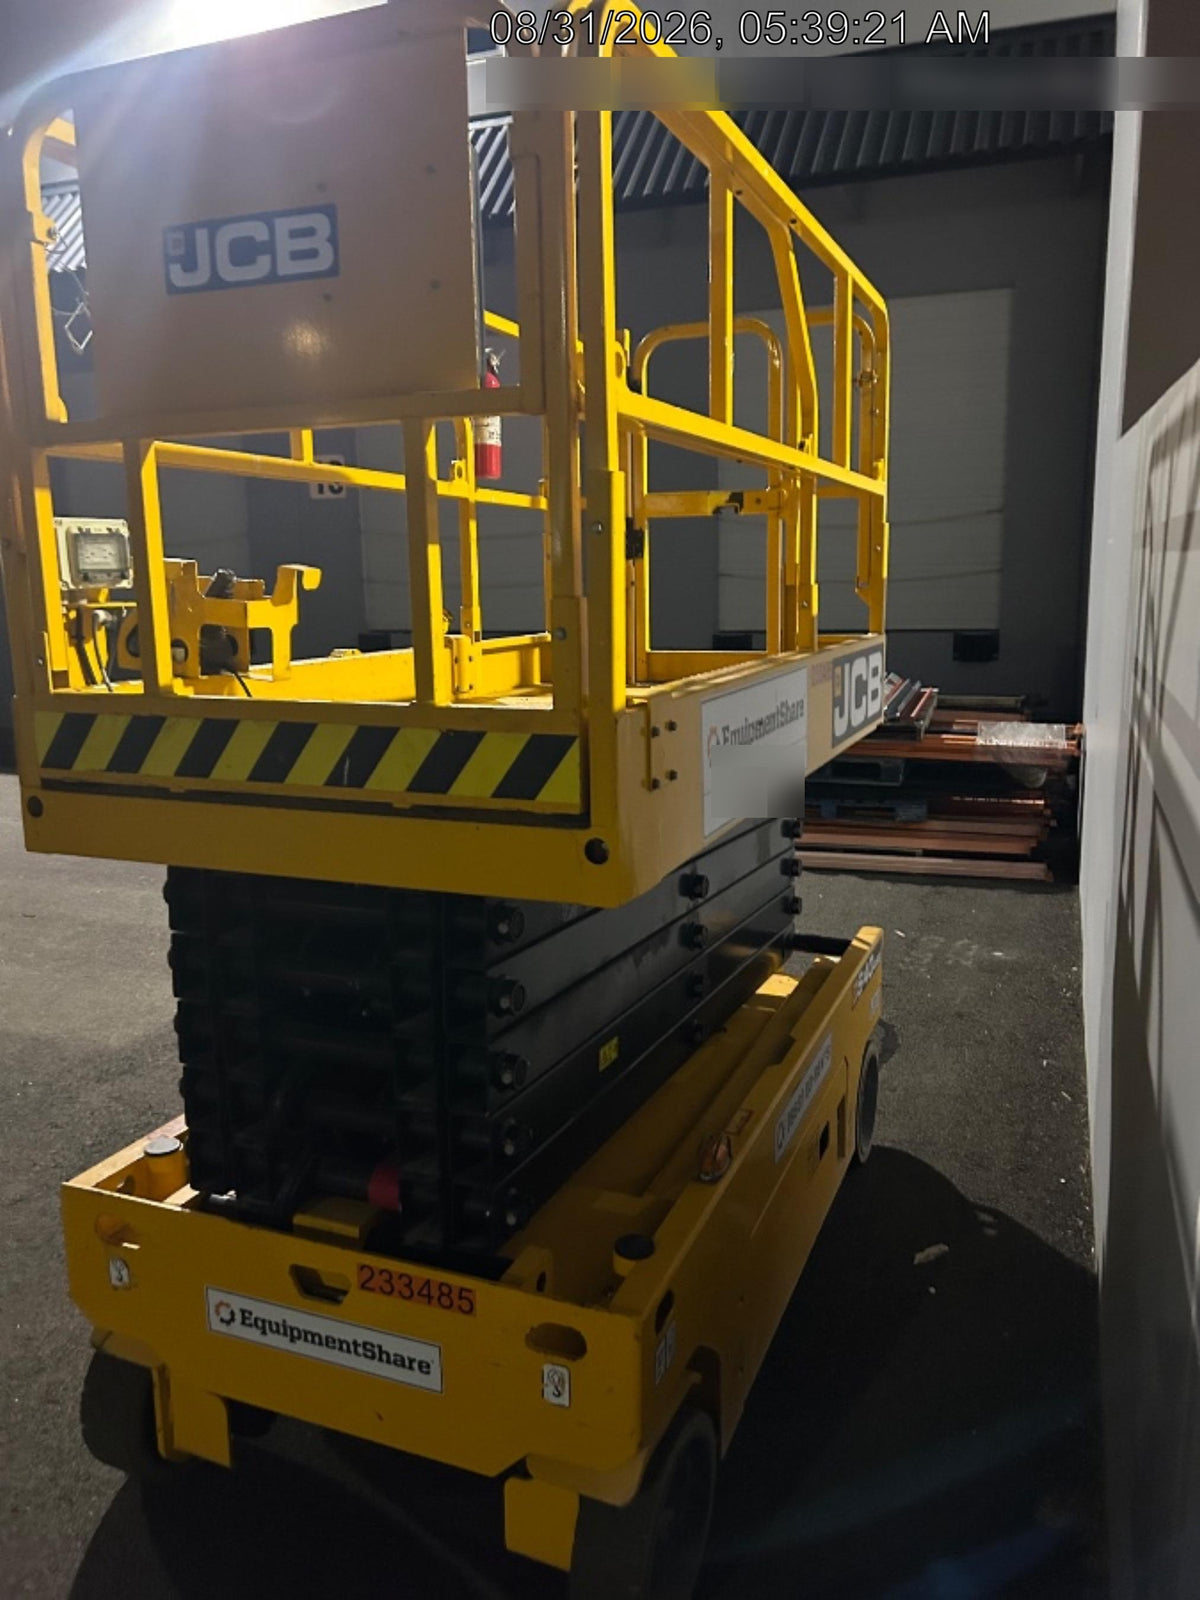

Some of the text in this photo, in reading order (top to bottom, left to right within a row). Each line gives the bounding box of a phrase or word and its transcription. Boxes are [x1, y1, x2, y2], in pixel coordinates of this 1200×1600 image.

[168, 212, 335, 288] JCB
[834, 651, 883, 737] JCB
[359, 1263, 475, 1316] 233485
[239, 1307, 431, 1376] EquipmentShare
